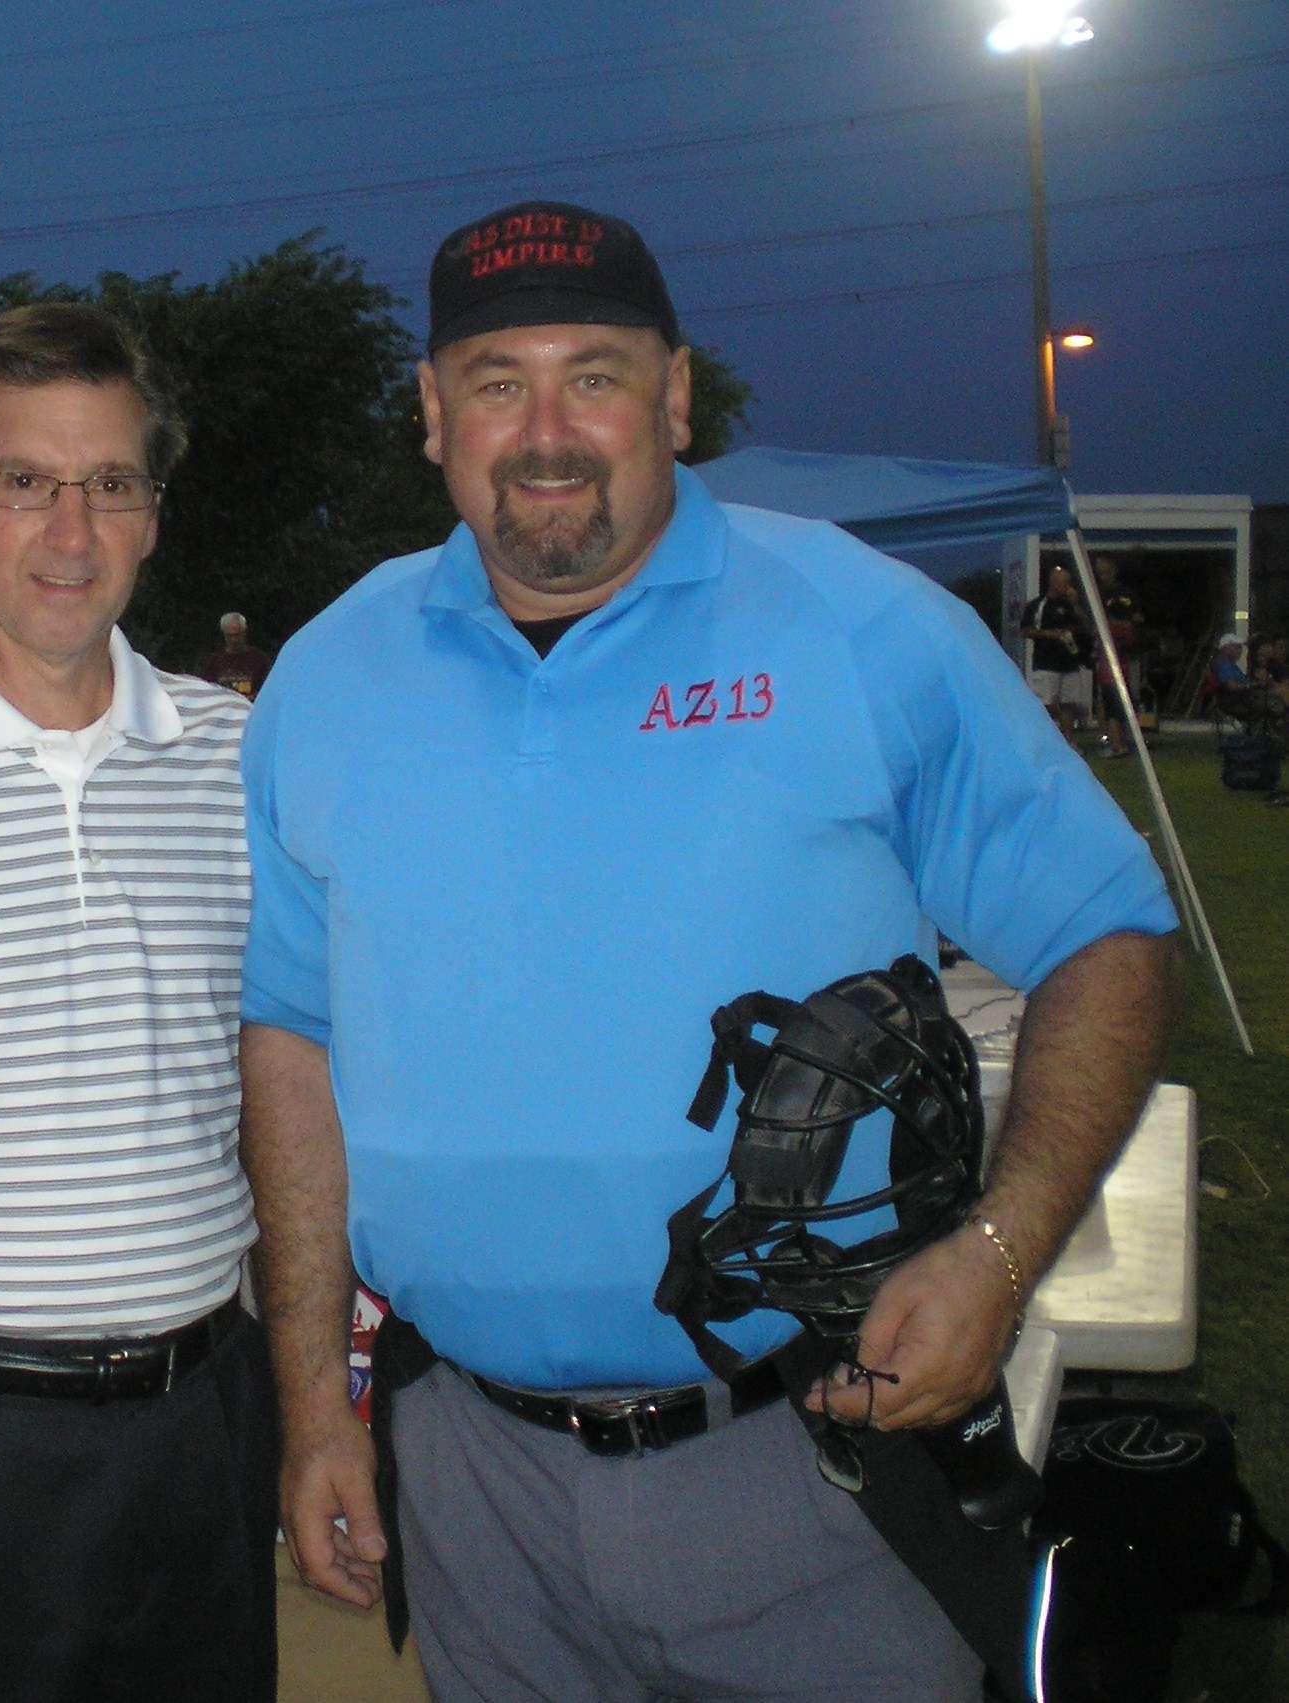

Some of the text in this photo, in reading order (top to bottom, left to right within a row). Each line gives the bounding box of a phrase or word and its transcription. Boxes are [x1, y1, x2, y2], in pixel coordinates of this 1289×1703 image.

[470, 242, 595, 278] UMPIRE
[639, 672, 775, 731] AZ 13
